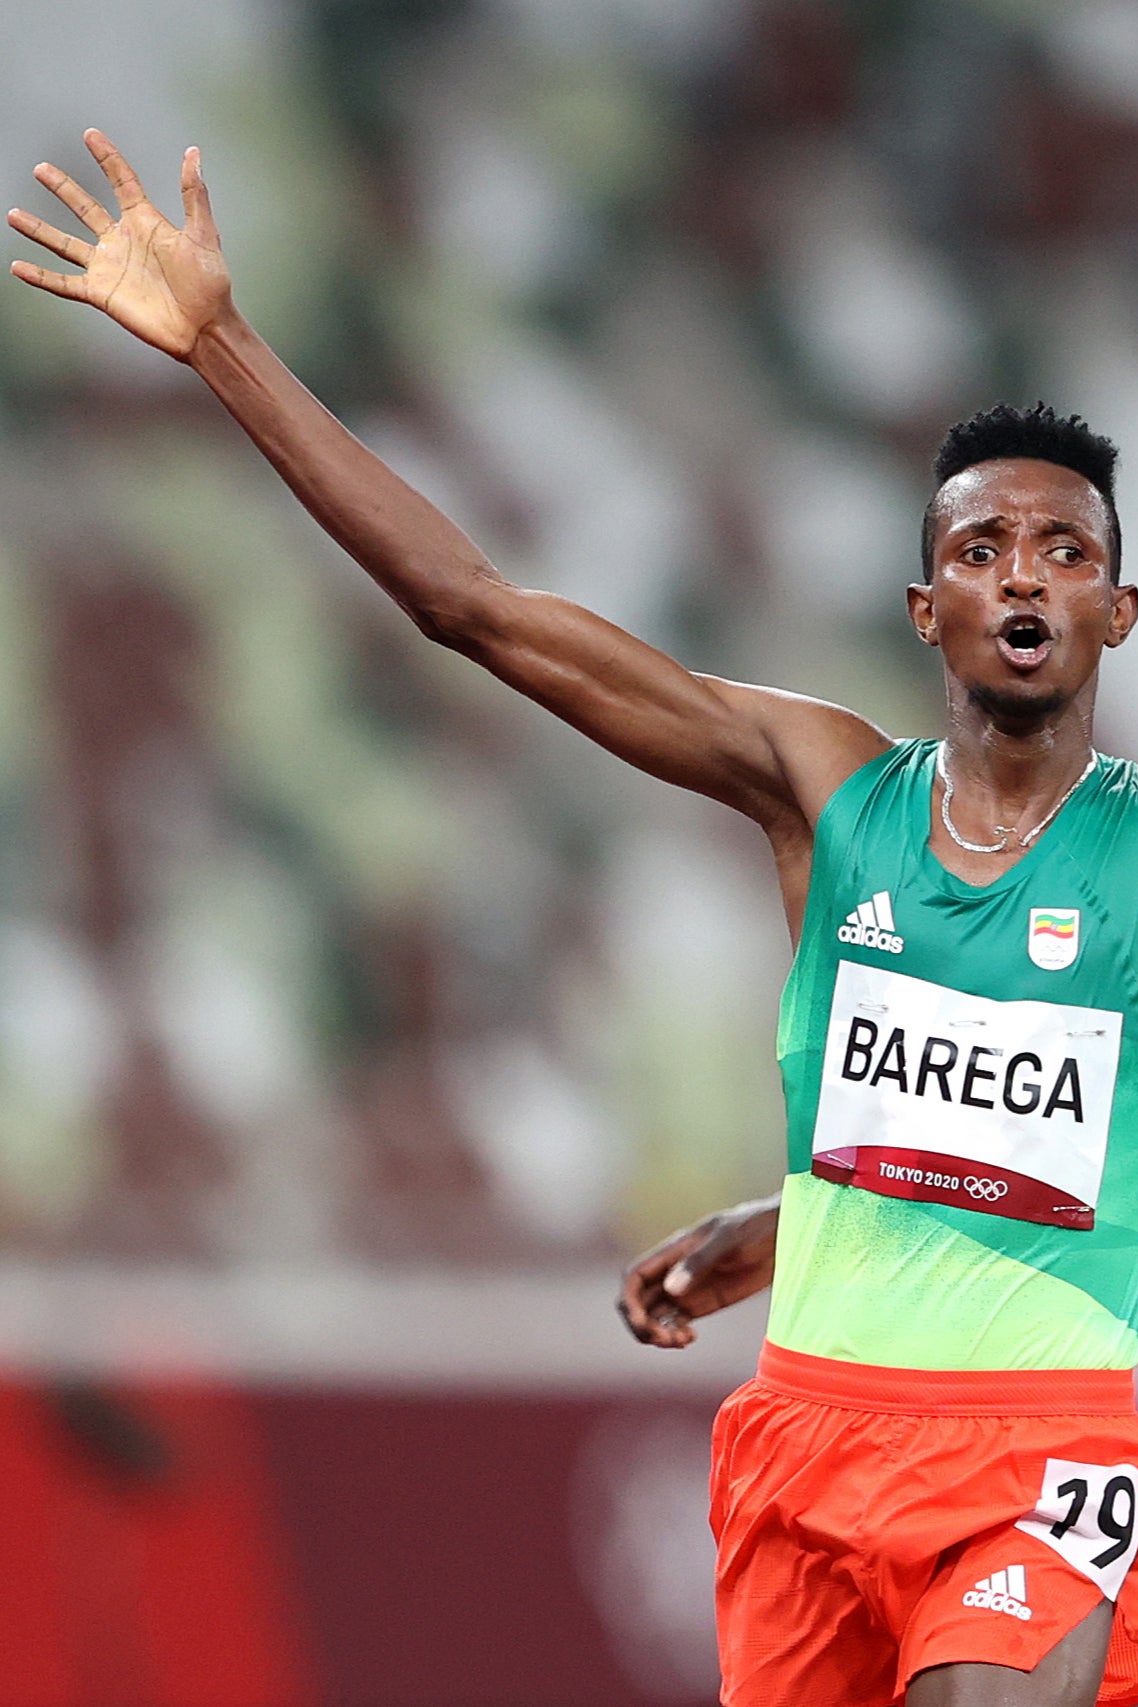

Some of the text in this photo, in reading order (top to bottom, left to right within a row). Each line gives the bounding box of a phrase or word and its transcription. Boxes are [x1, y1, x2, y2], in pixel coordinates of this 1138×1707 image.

[837, 922, 905, 954] adidas
[841, 1016, 1084, 1123] BAREGA
[879, 1162, 960, 1190] TOKYO 2020
[1050, 1475, 1136, 1570] 19
[962, 1589, 1034, 1621] adidas
